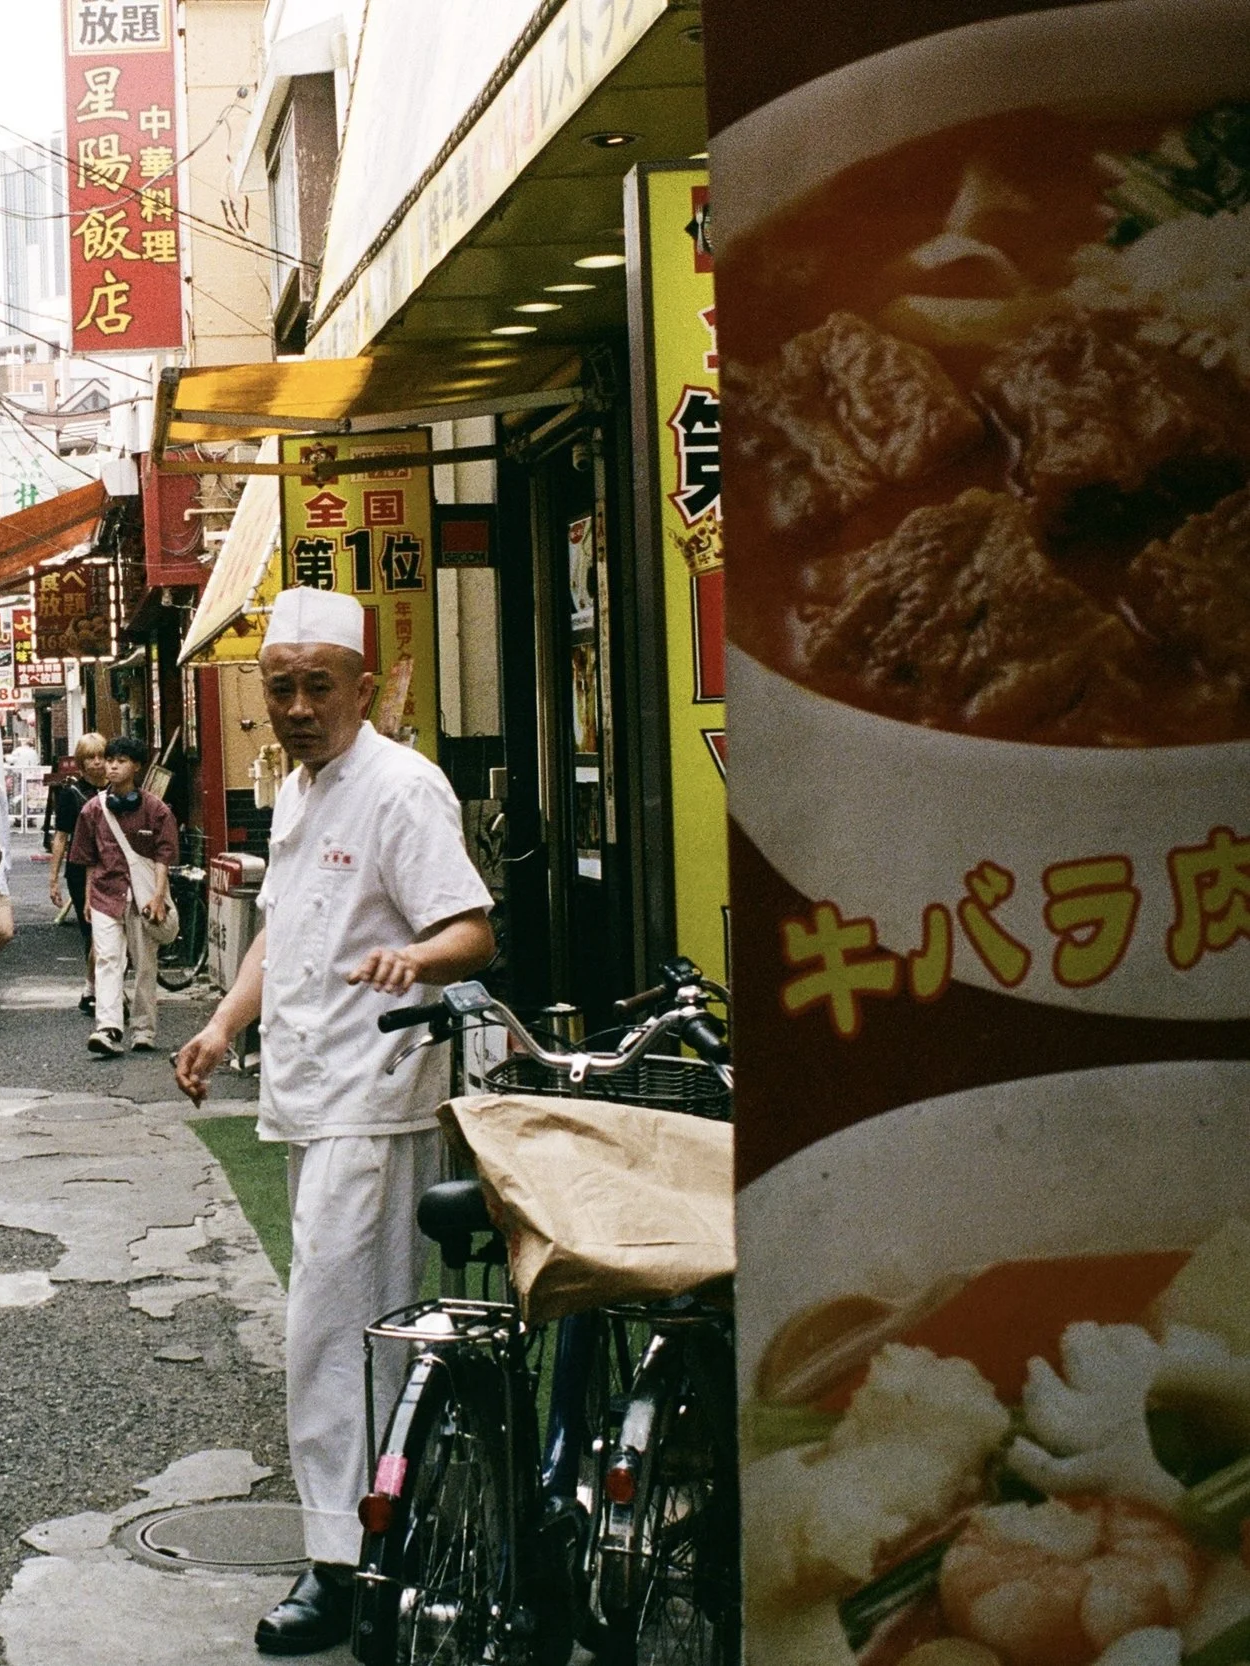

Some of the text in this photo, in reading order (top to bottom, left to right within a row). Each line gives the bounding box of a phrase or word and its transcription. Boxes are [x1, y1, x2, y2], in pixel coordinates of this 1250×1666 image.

[79, 5, 160, 45] 放題
[71, 65, 141, 336] 星陽飯店
[139, 104, 178, 263] 中華料理
[302, 489, 406, 529] 全国
[39, 566, 87, 592] 食べ
[290, 528, 426, 594] 第1位
